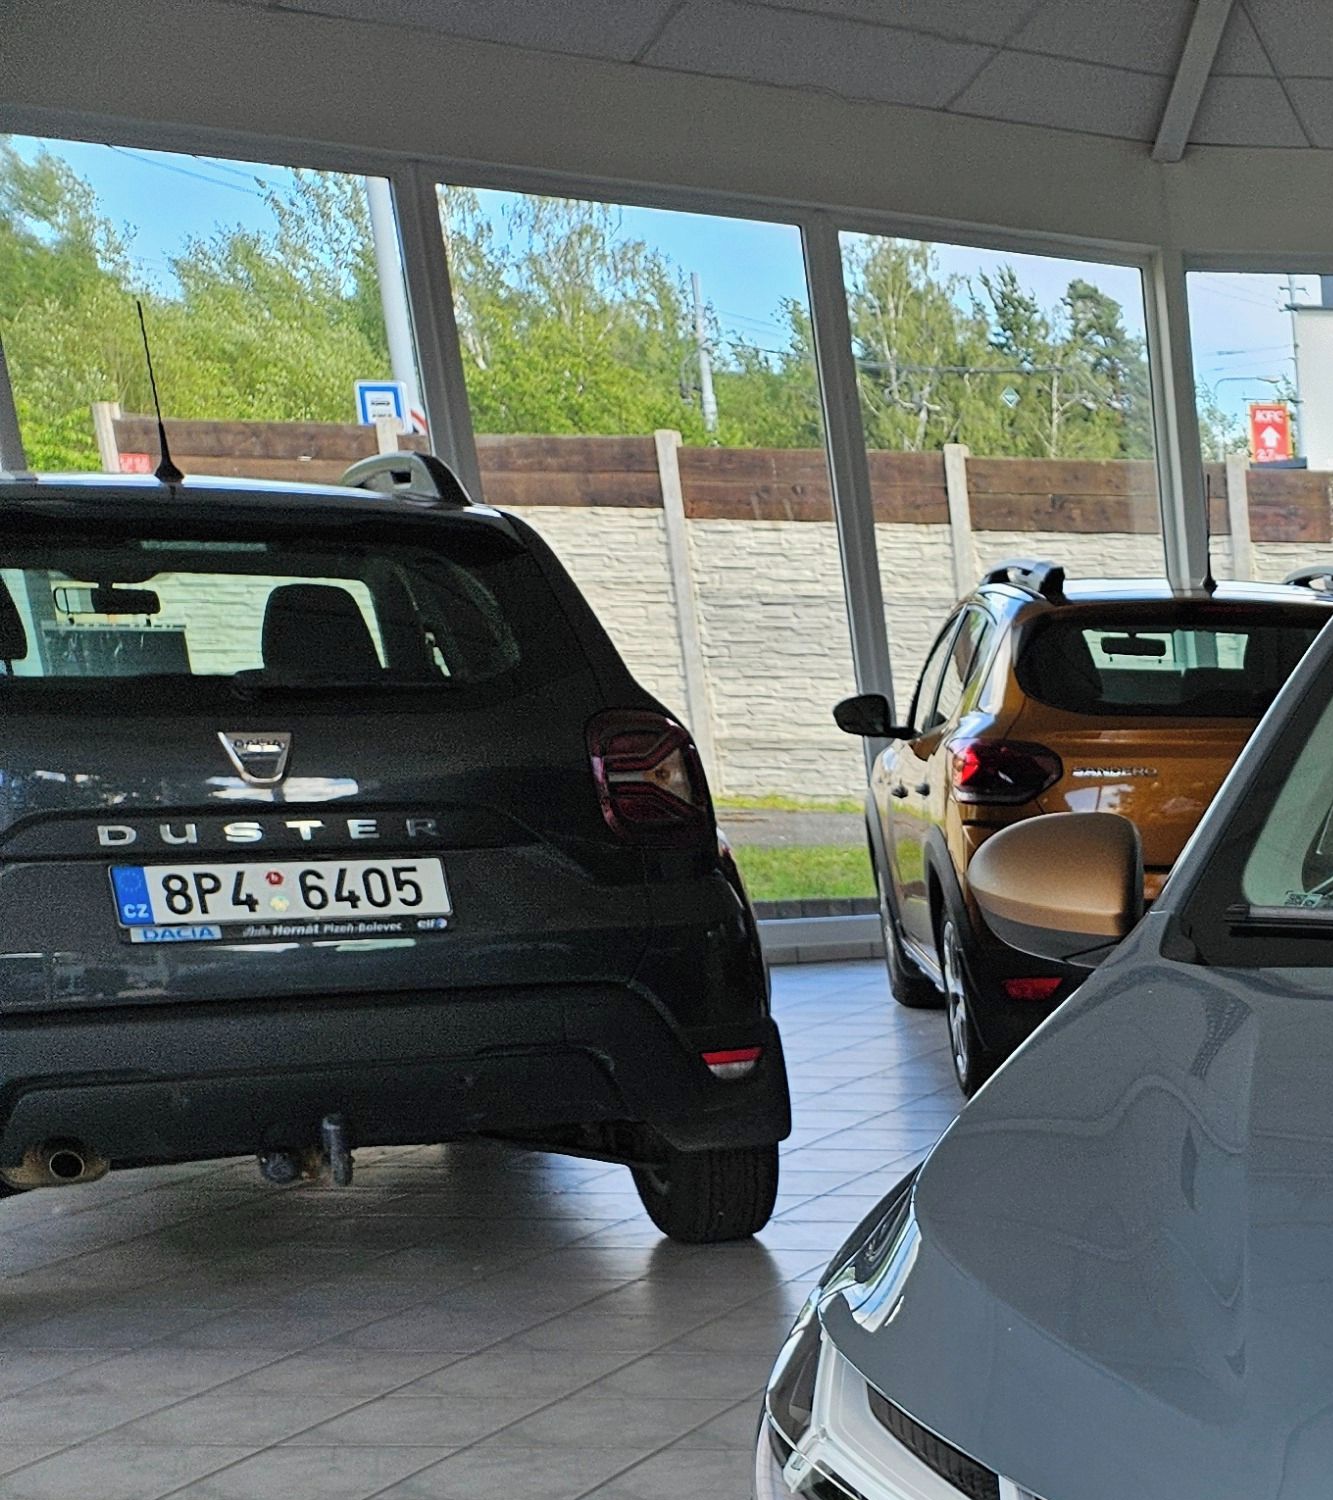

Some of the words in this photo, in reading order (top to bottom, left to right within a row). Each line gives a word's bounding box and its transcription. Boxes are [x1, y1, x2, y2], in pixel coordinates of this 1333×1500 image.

[1071, 767, 1158, 777] SANDERO
[96, 818, 438, 847] DUSTER
[161, 870, 259, 916] 8P4
[299, 866, 424, 911] 6405
[123, 903, 149, 919] CZ
[142, 926, 214, 941] DACIA
[272, 922, 319, 937] Hornát
